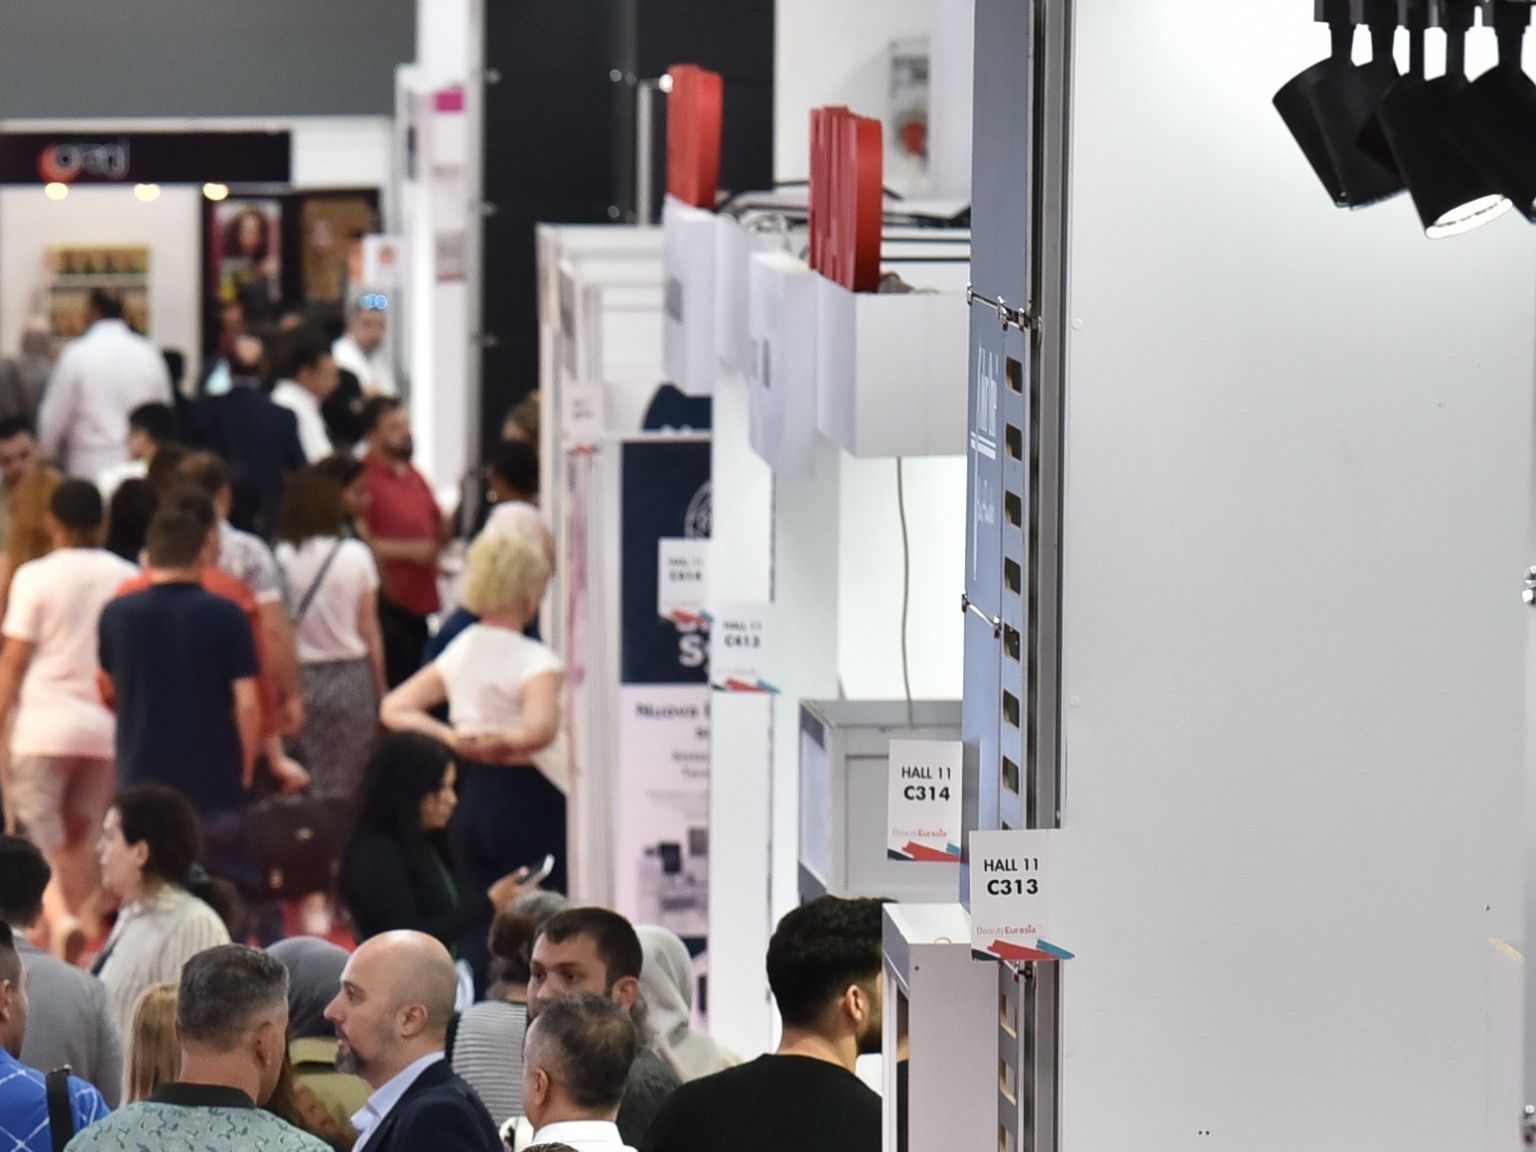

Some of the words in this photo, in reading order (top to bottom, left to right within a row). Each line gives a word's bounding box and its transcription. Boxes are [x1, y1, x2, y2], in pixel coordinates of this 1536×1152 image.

[901, 766, 932, 780] HALL
[938, 766, 951, 780] 11
[903, 785, 950, 802] C314
[984, 858, 1018, 873] HALL
[1024, 857, 1039, 872] 11
[987, 878, 1039, 896] C313
[976, 924, 1036, 937] BeautyEurasia
